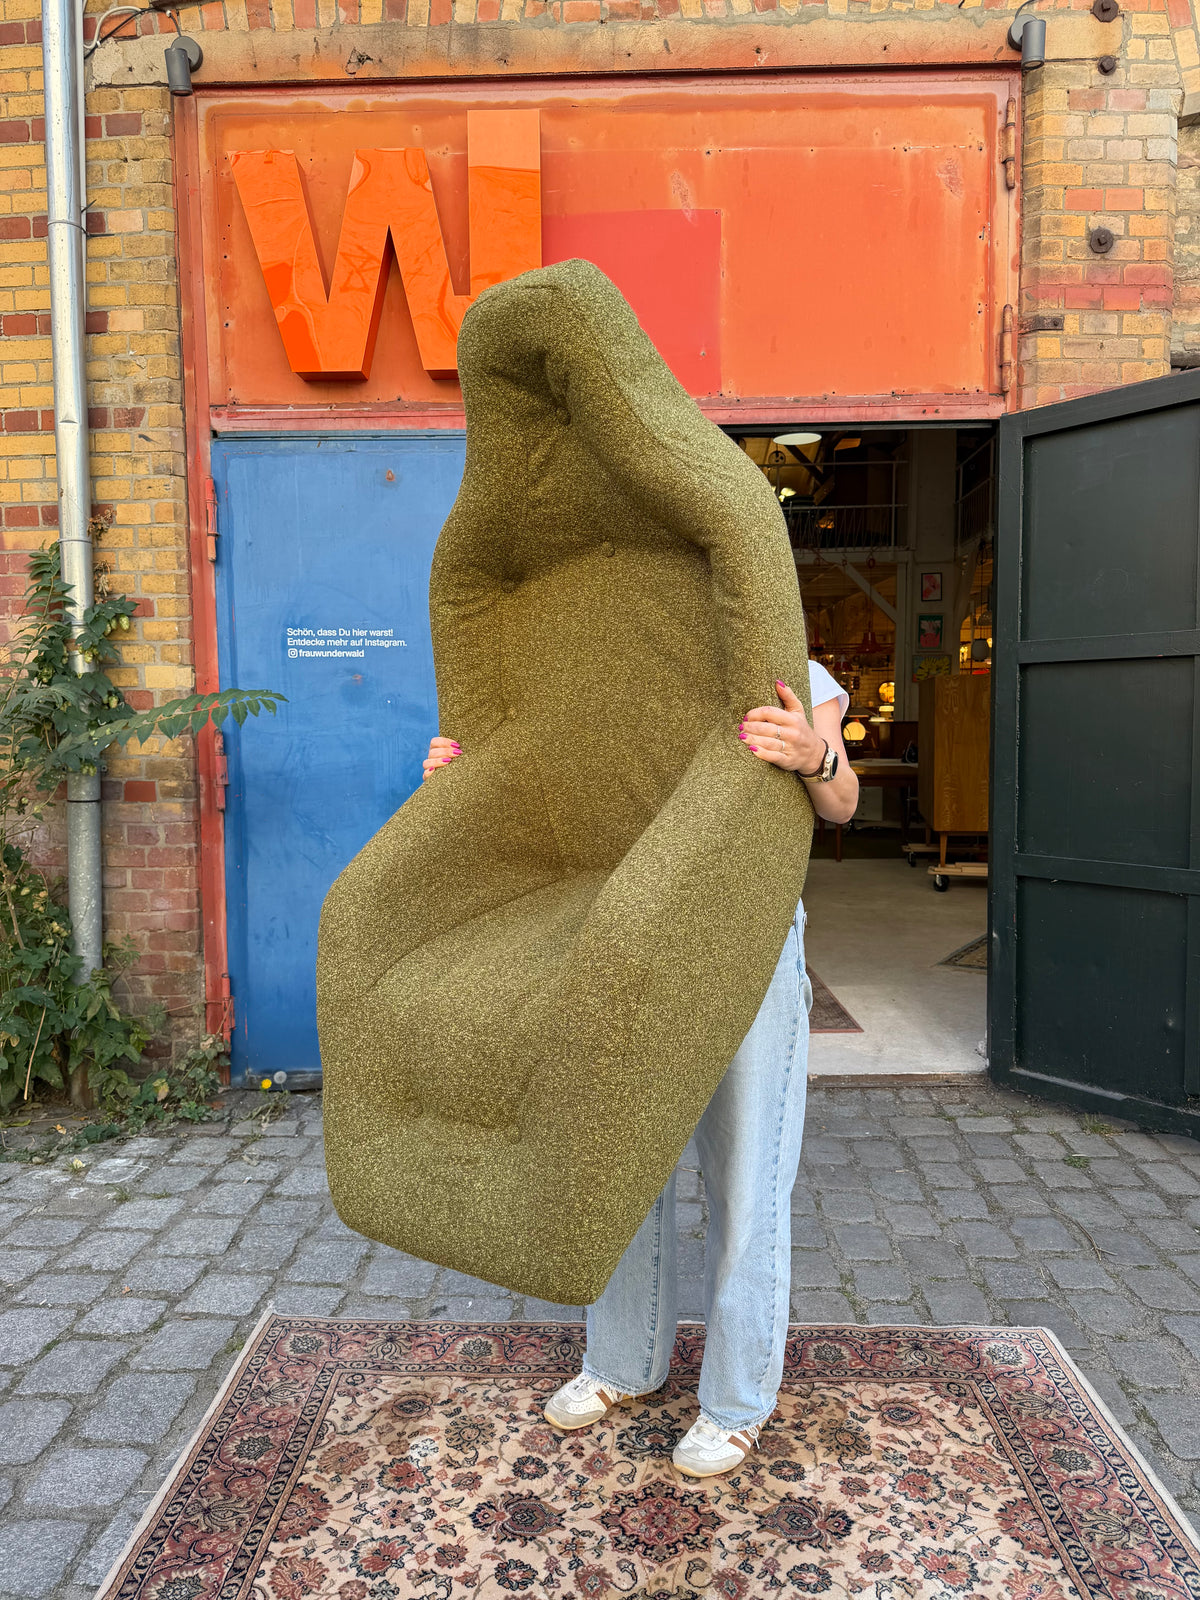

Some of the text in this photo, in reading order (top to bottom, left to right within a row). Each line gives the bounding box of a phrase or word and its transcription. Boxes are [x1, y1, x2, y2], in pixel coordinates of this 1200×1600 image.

[286, 627, 394, 637] Schön, dass Du hier warst!
[287, 638, 408, 648] Entdecke mehr auf Instagram.
[298, 649, 365, 658] frauwunderwald
